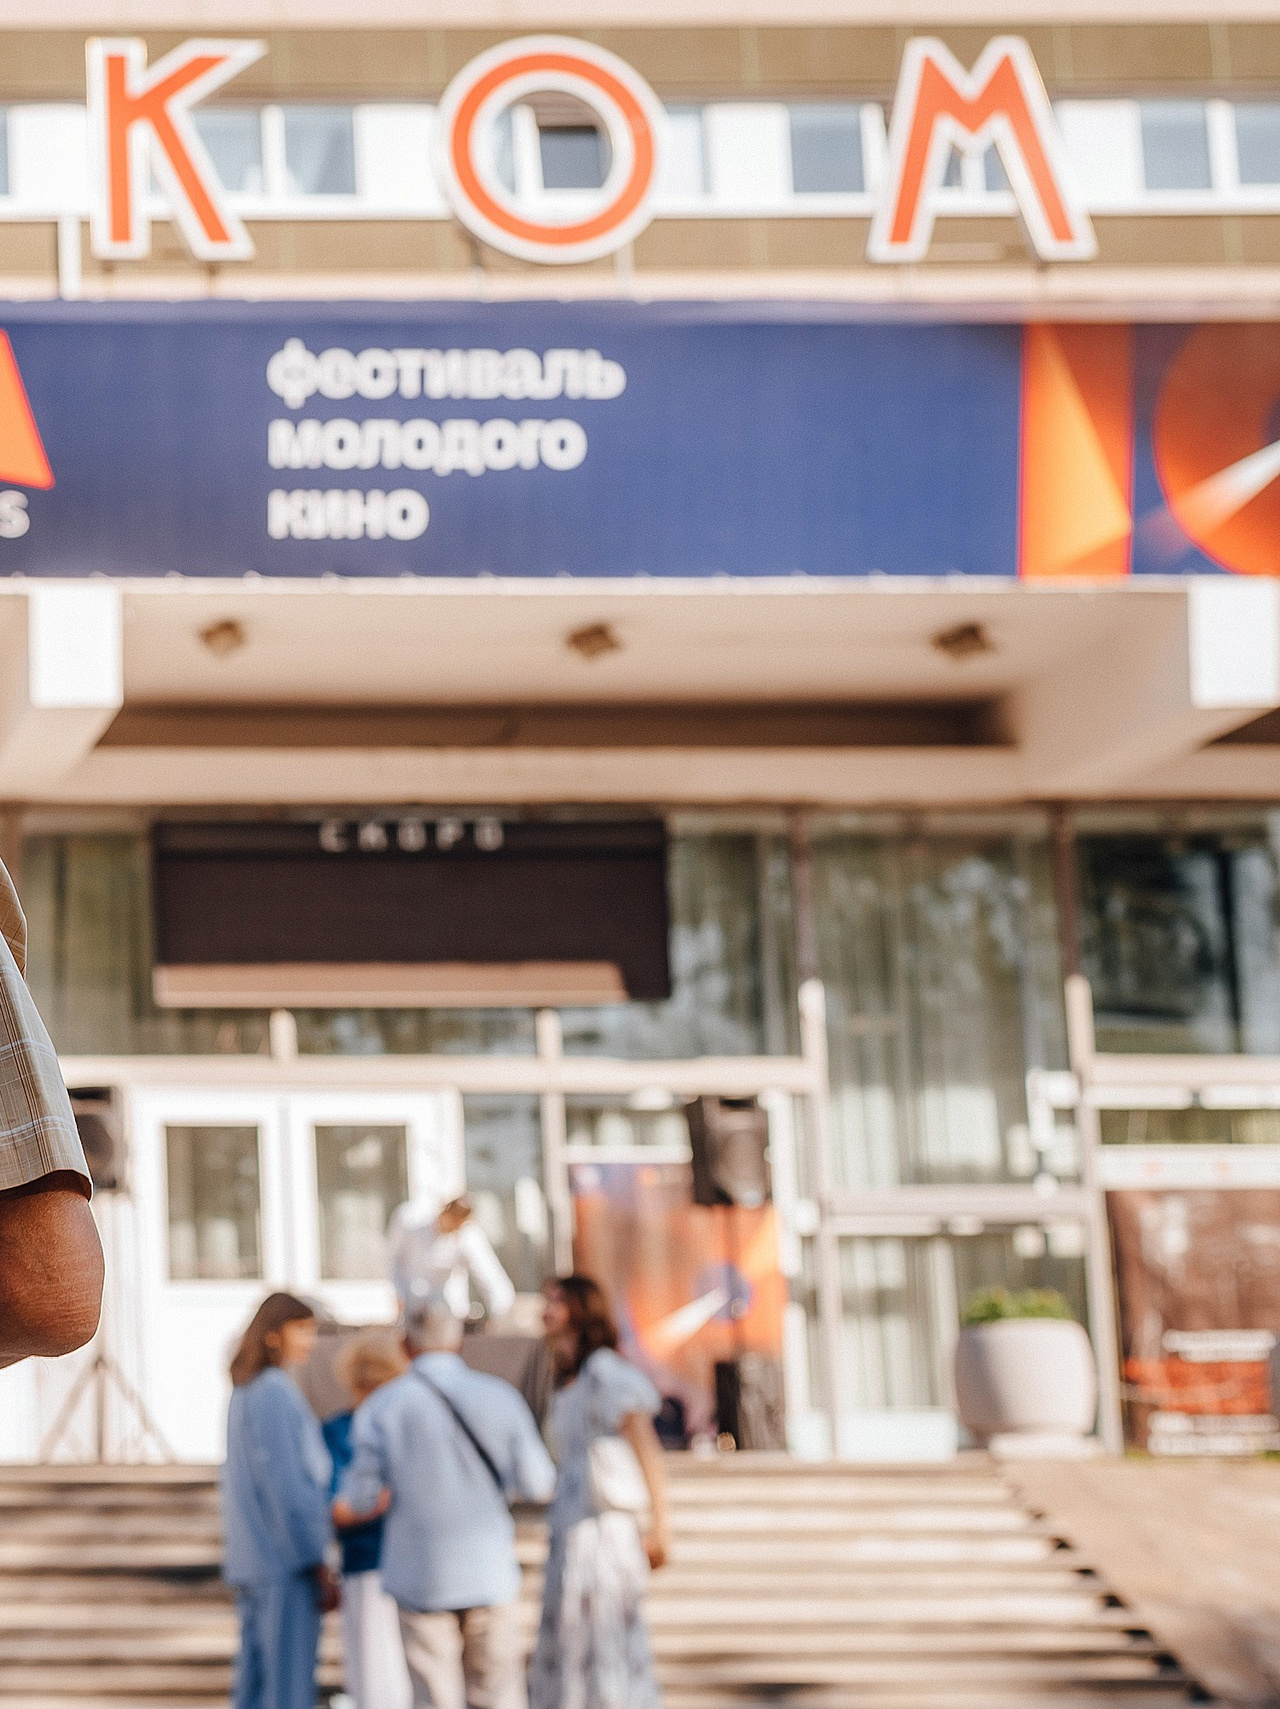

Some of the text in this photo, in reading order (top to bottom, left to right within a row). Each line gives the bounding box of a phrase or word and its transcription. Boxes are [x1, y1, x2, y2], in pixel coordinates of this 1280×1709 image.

[268, 418, 588, 477] молодого
[268, 488, 430, 541] кино
[320, 816, 504, 852] СКОРО
